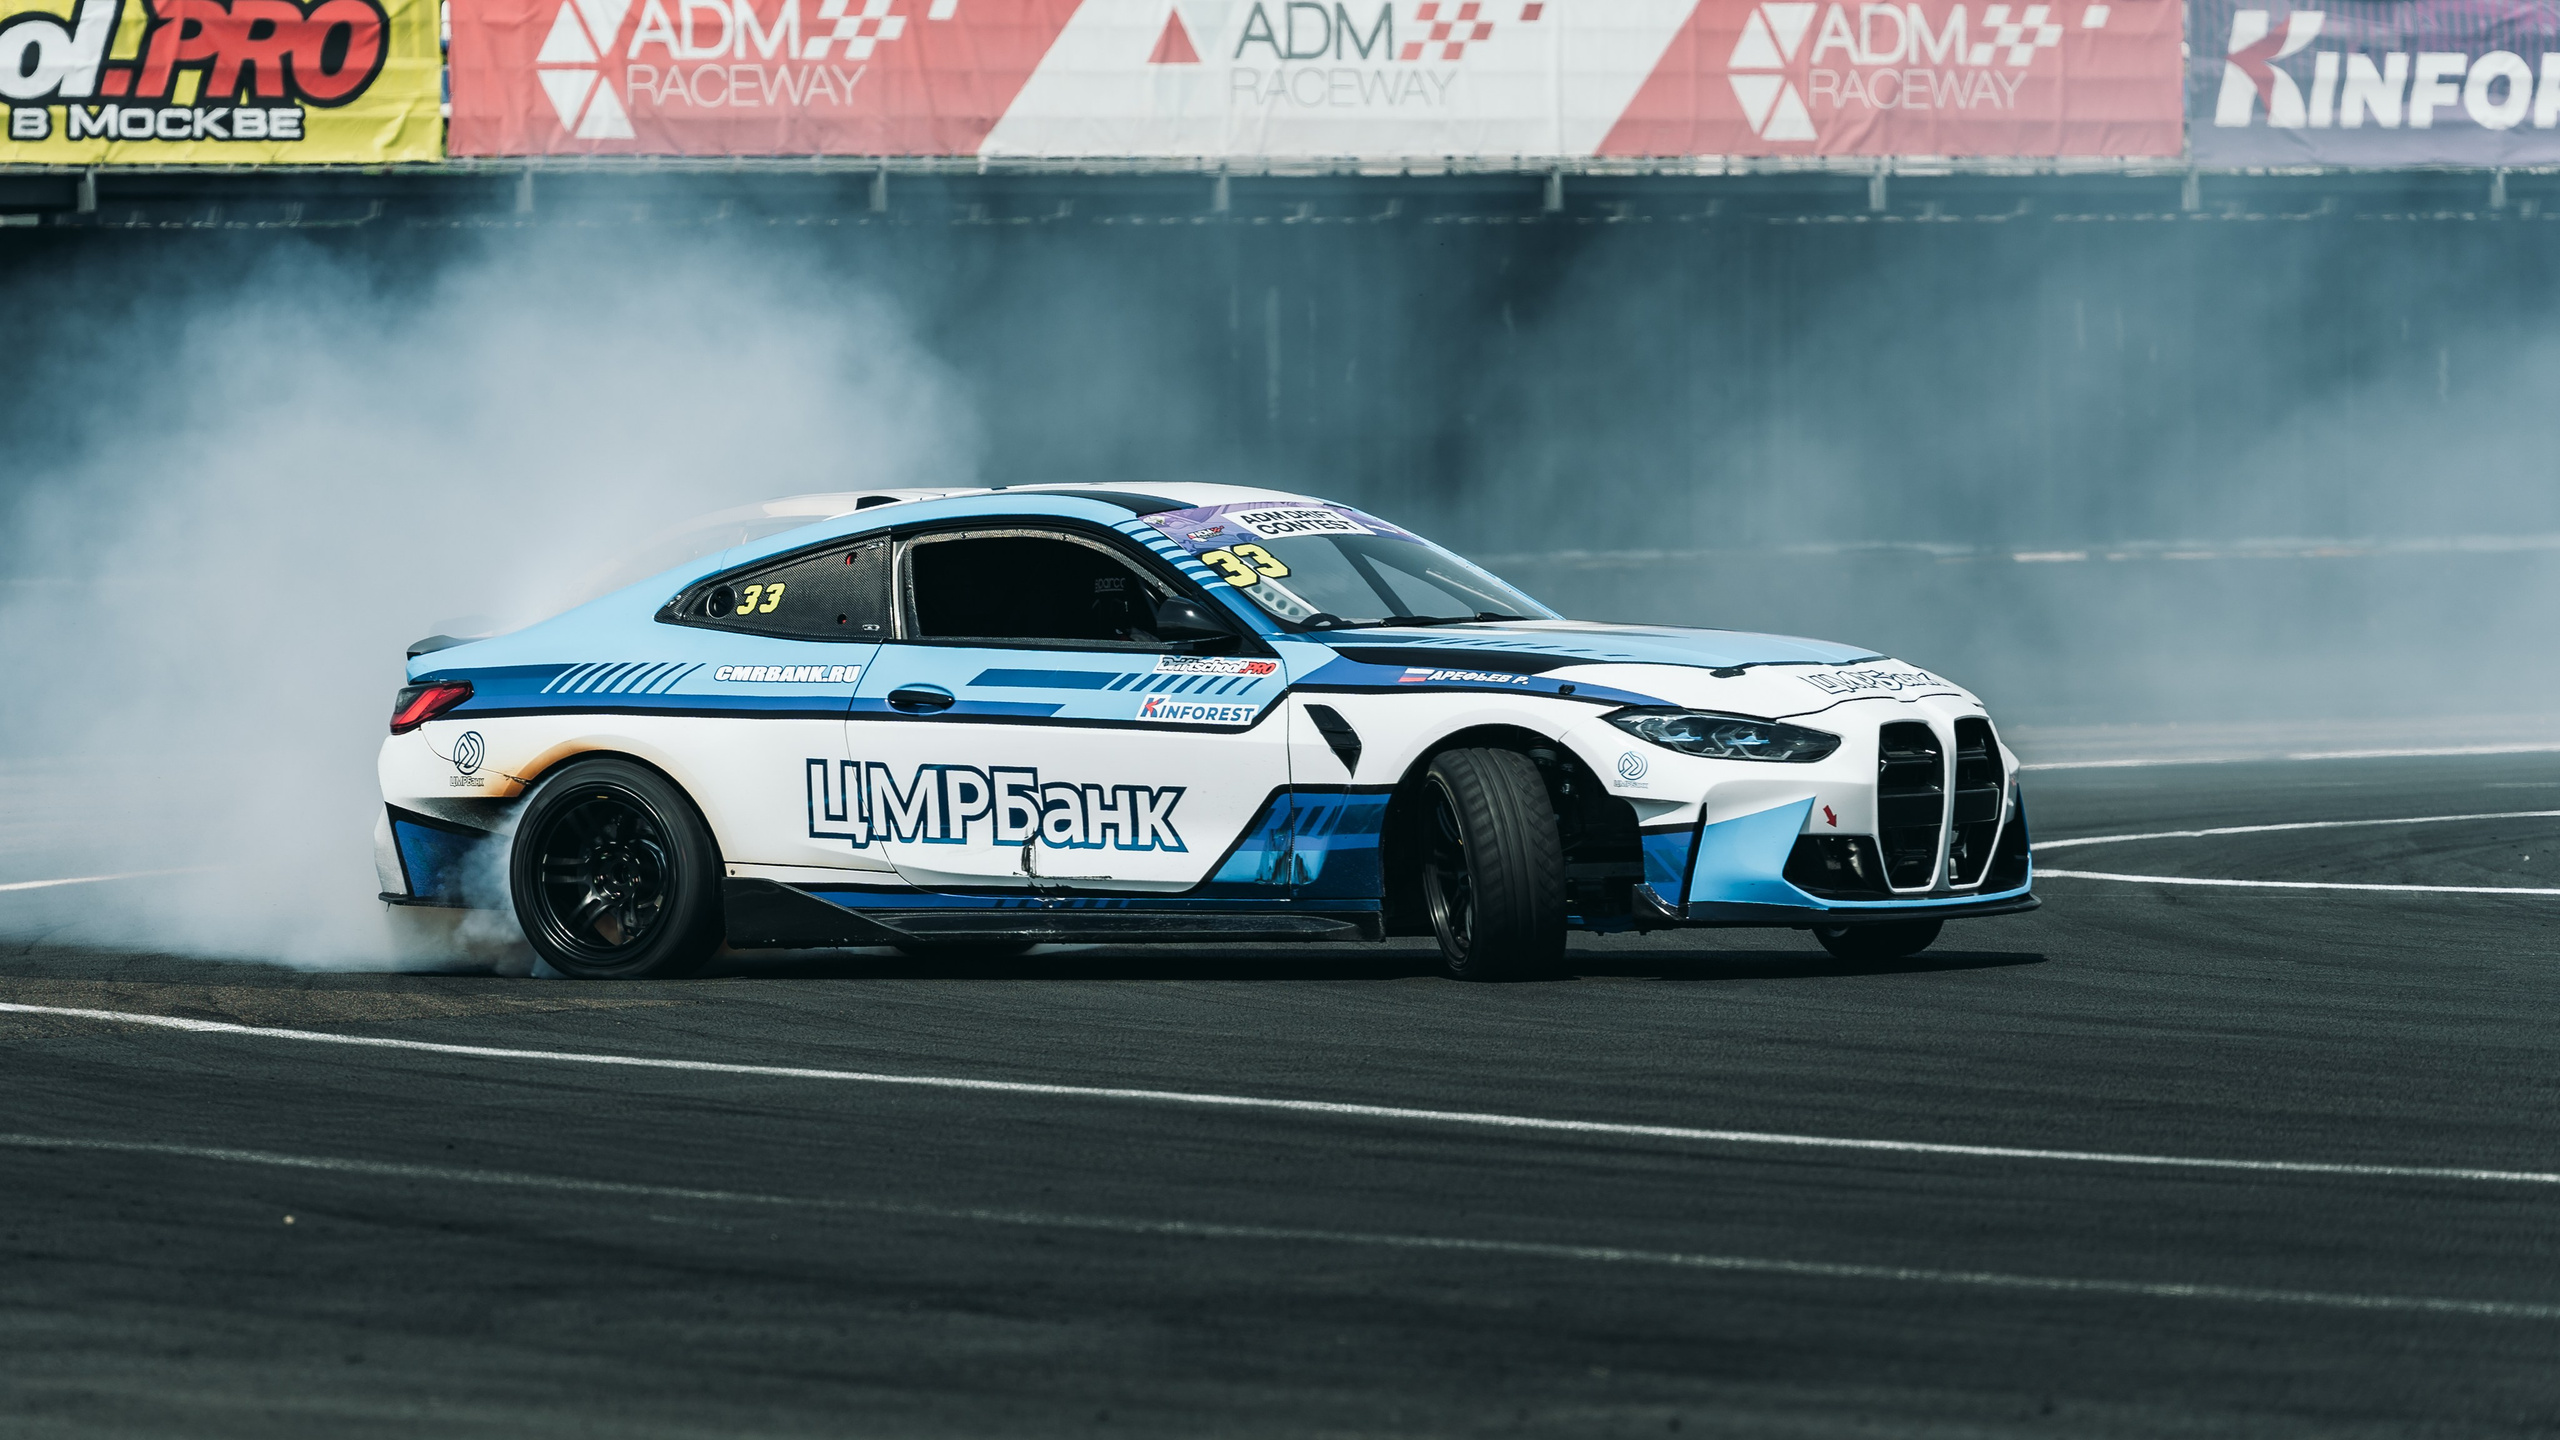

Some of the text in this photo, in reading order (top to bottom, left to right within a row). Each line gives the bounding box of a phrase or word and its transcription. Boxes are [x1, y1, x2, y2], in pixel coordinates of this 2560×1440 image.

[626, 0, 800, 60] ADM
[1234, 2, 1394, 60] ADM
[1810, 3, 1968, 65] ADM
[626, 63, 866, 107] RACEWAY
[1229, 67, 1459, 108] RACEWAY
[1808, 68, 2028, 110] RACEWAY
[1239, 510, 1338, 525] ADM DRIFT
[1256, 519, 1359, 535] CONTEST
[1200, 543, 1292, 589] 33
[736, 582, 786, 616] 33
[714, 664, 862, 683] CMRBANK.RU
[1427, 670, 1529, 685] АРЕФЬЕВ Р.
[1140, 697, 1256, 722] KINFOREST
[805, 758, 1189, 854] ЦМРБанк
